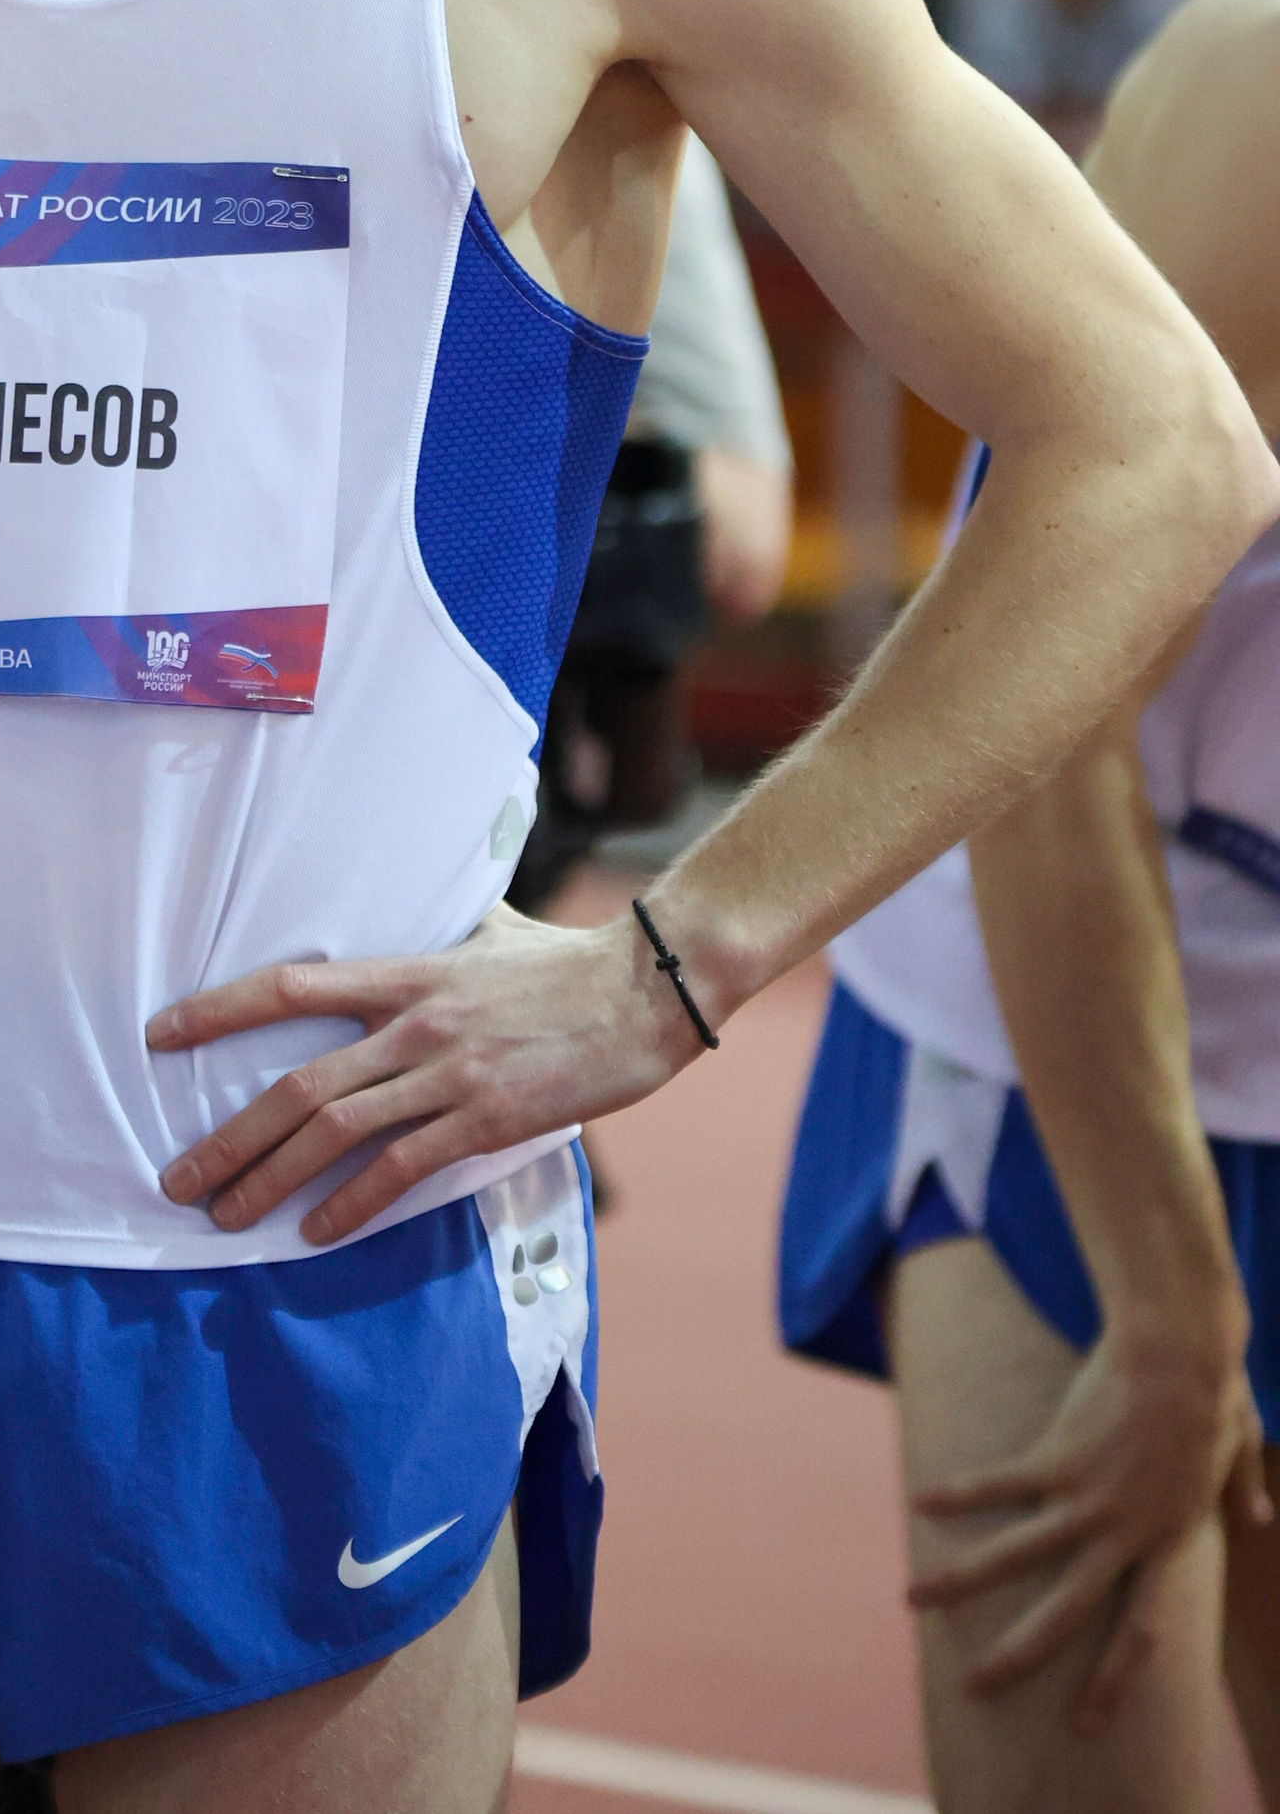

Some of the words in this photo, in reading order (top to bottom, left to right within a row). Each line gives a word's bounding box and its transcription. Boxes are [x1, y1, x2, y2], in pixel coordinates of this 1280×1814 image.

[37, 195, 203, 225] РОССИИ
[211, 196, 316, 231] 2023
[136, 670, 193, 684] МИНСПОРТ
[143, 681, 185, 693] РОССИИ
